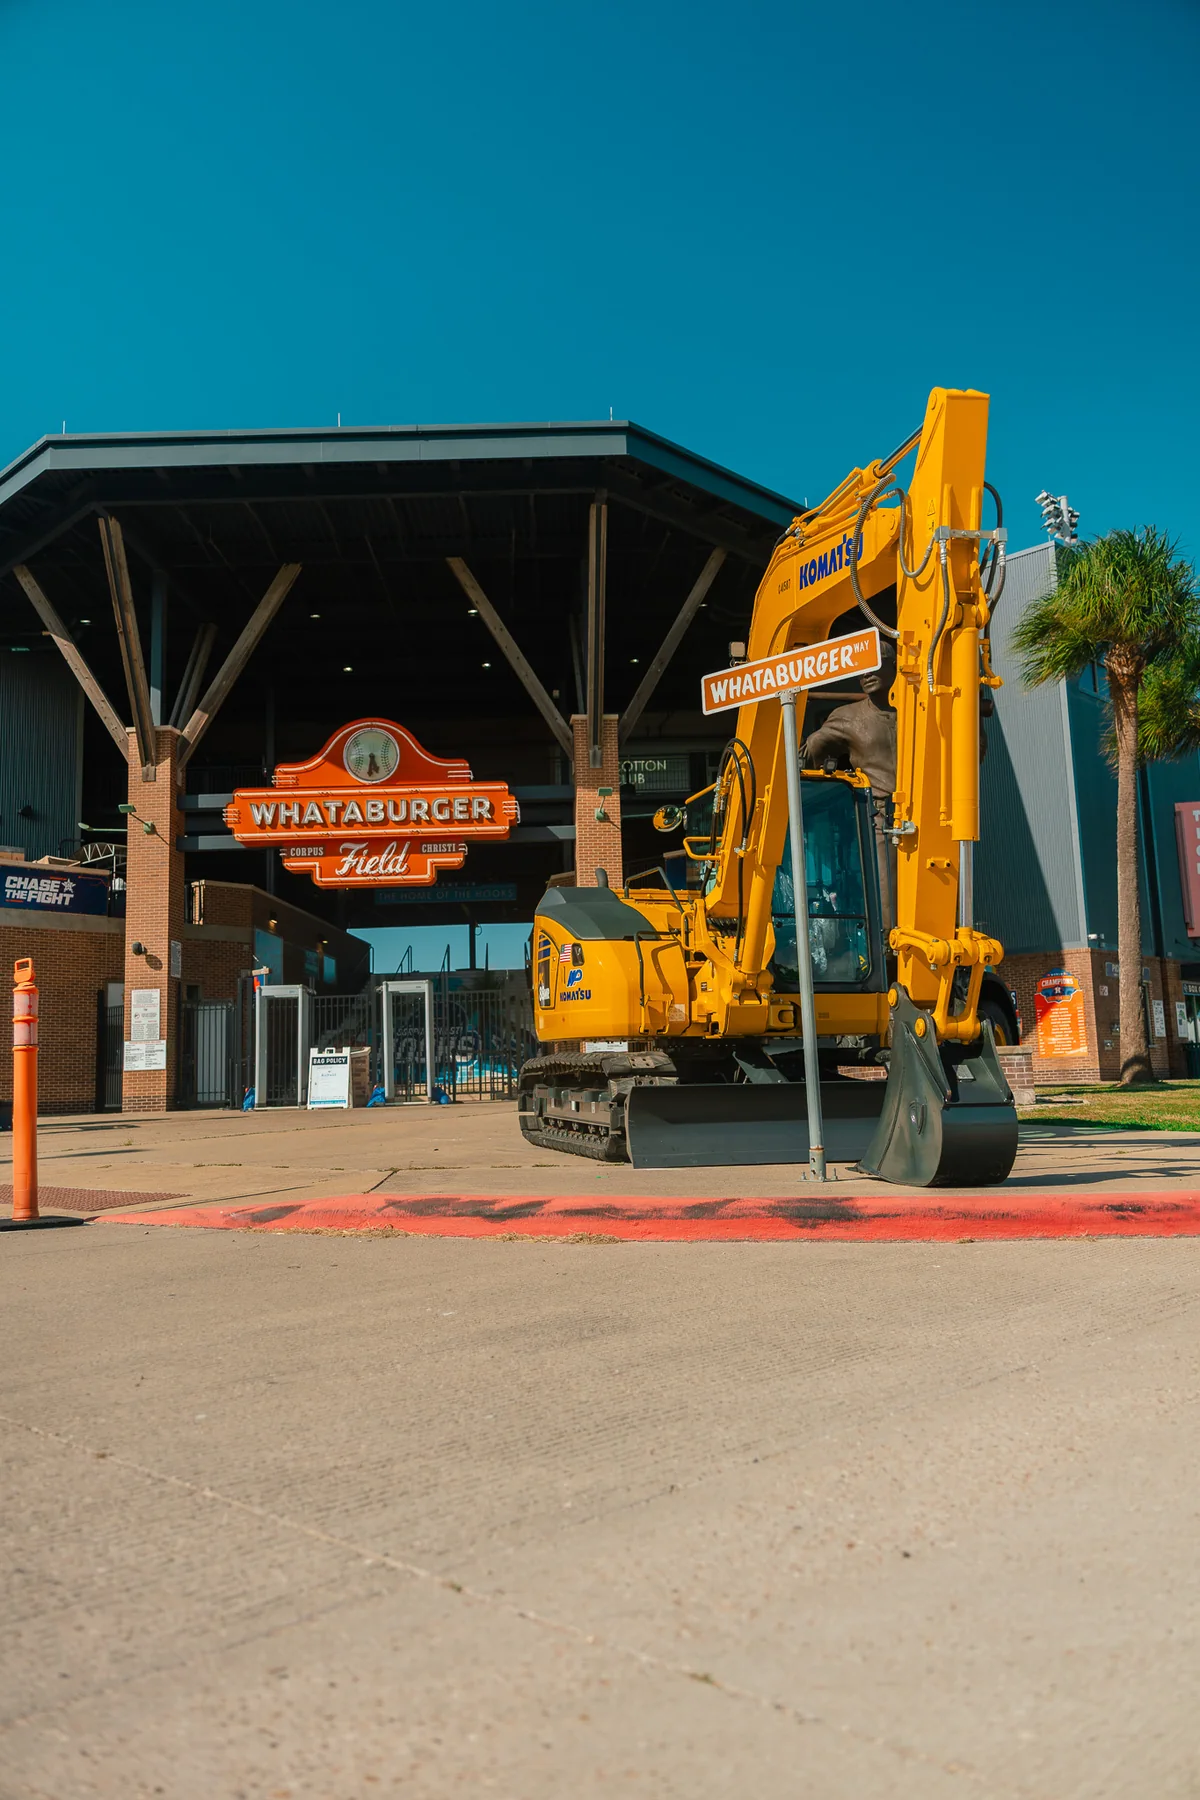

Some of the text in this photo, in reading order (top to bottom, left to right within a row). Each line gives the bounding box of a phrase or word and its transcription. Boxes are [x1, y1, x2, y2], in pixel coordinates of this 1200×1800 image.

[799, 532, 864, 591] KOMATSU
[710, 639, 870, 704] WHATABURGER WAY
[619, 773, 645, 784] LUB
[249, 796, 493, 827] WHATABURGER
[290, 846, 324, 857] CORPUS
[421, 843, 456, 854] CHRISTI
[335, 841, 412, 876] Field
[5, 875, 61, 893] CHASE
[5, 889, 75, 906] THE FIGHT
[1041, 977, 1074, 987] CHAMPIONS
[560, 987, 592, 1002] KOMATSU
